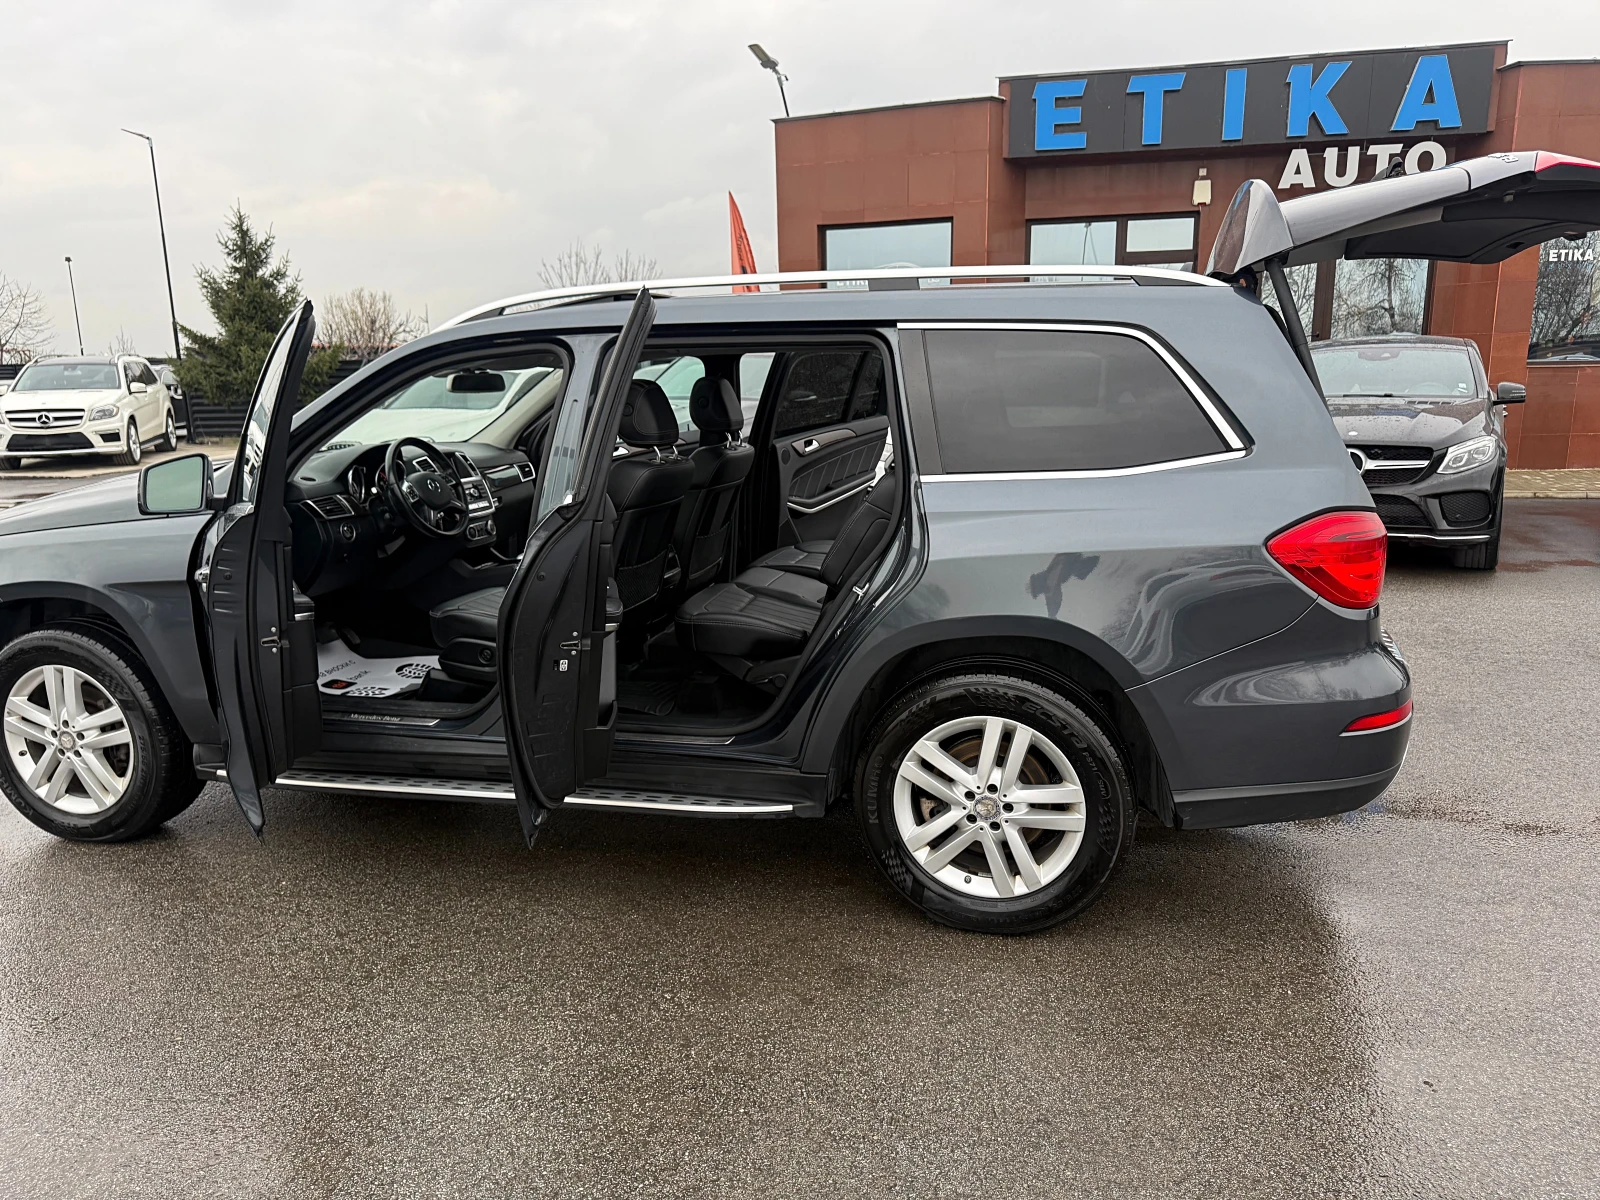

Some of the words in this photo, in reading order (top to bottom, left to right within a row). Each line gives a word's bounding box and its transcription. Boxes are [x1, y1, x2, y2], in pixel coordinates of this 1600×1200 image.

[1032, 54, 1462, 151] ETIKA
[1277, 141, 1447, 189] AUTO
[1548, 248, 1594, 261] ETIKA
[0, 771, 34, 816] KUMH
[867, 755, 885, 824] KUMHO
